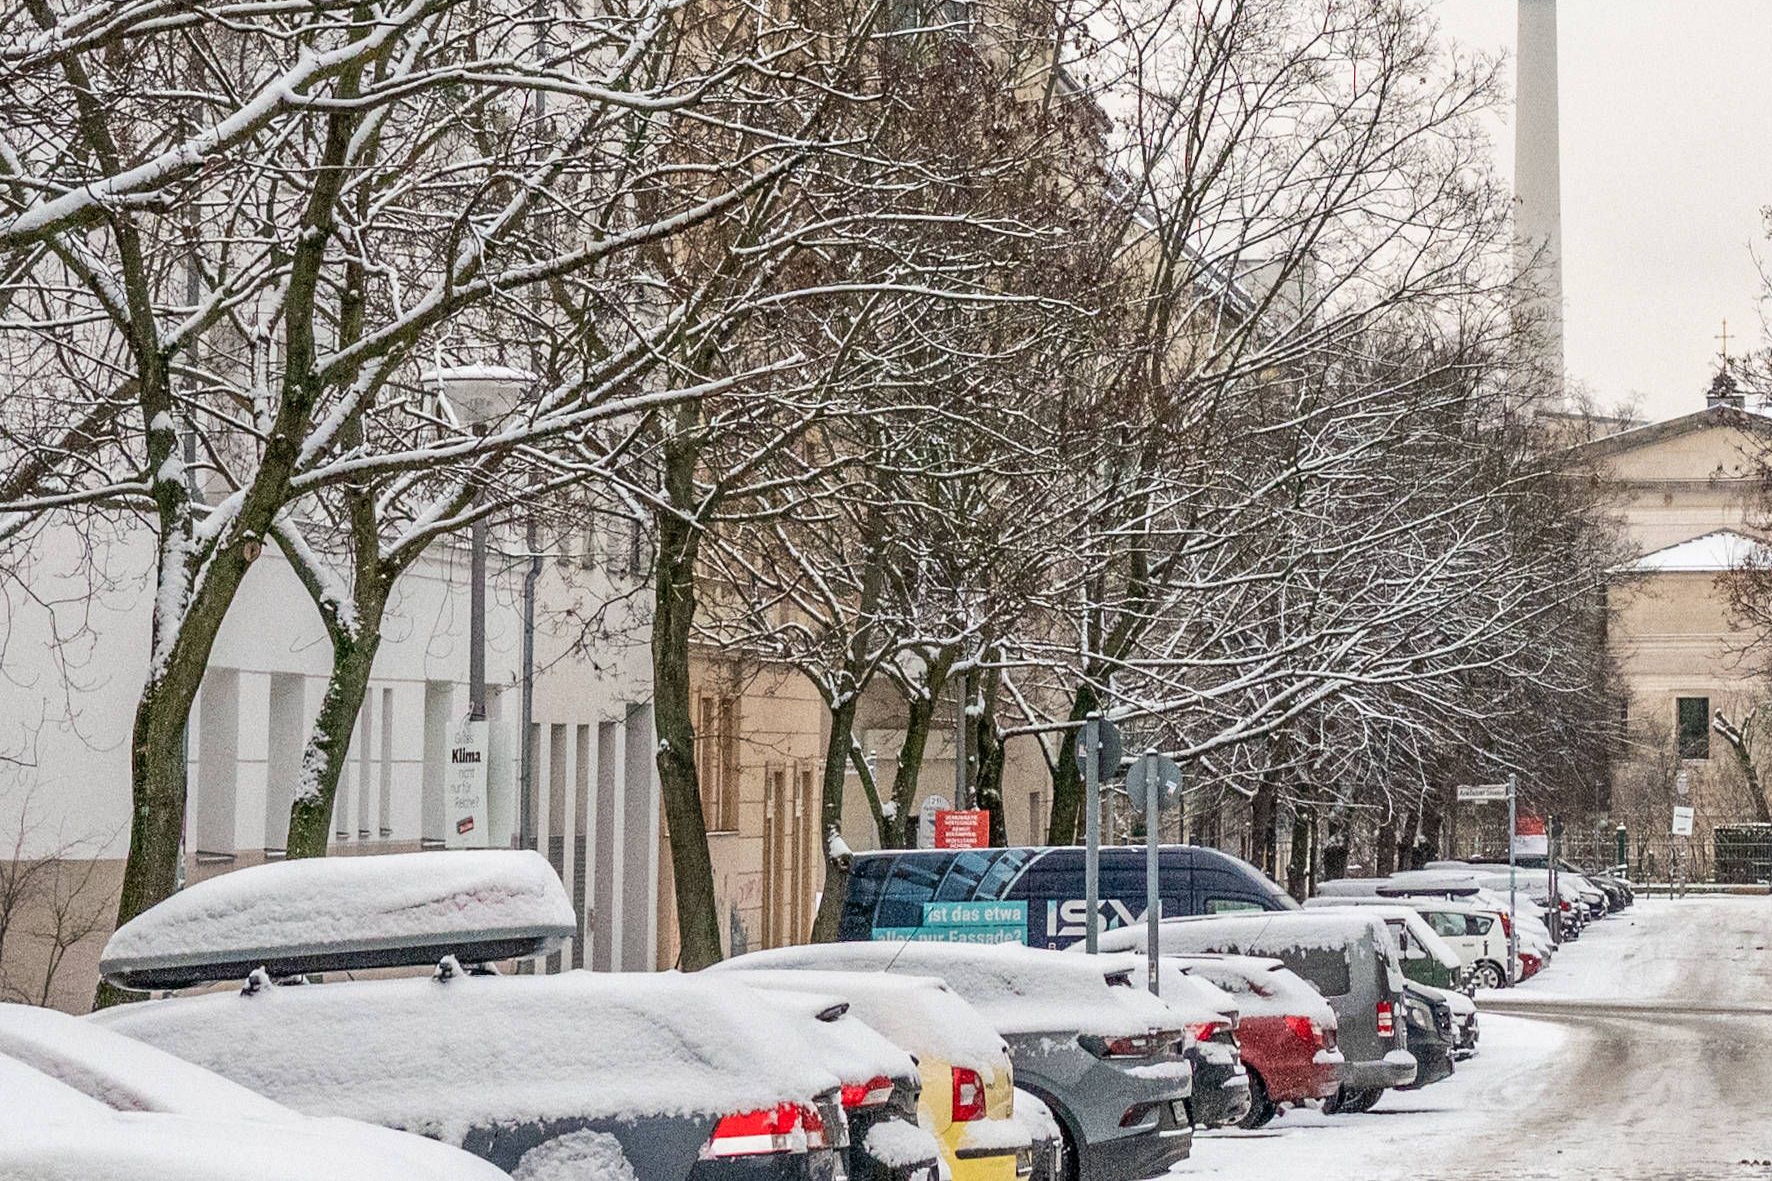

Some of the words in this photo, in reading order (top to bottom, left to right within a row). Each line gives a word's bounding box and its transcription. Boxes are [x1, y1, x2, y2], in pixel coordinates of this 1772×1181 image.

[452, 747, 482, 764] Klima
[928, 906, 947, 922] ist
[952, 905, 979, 922] das
[984, 907, 1021, 922] etwa
[918, 934, 945, 943] nur
[949, 930, 1022, 945] Fassade?
